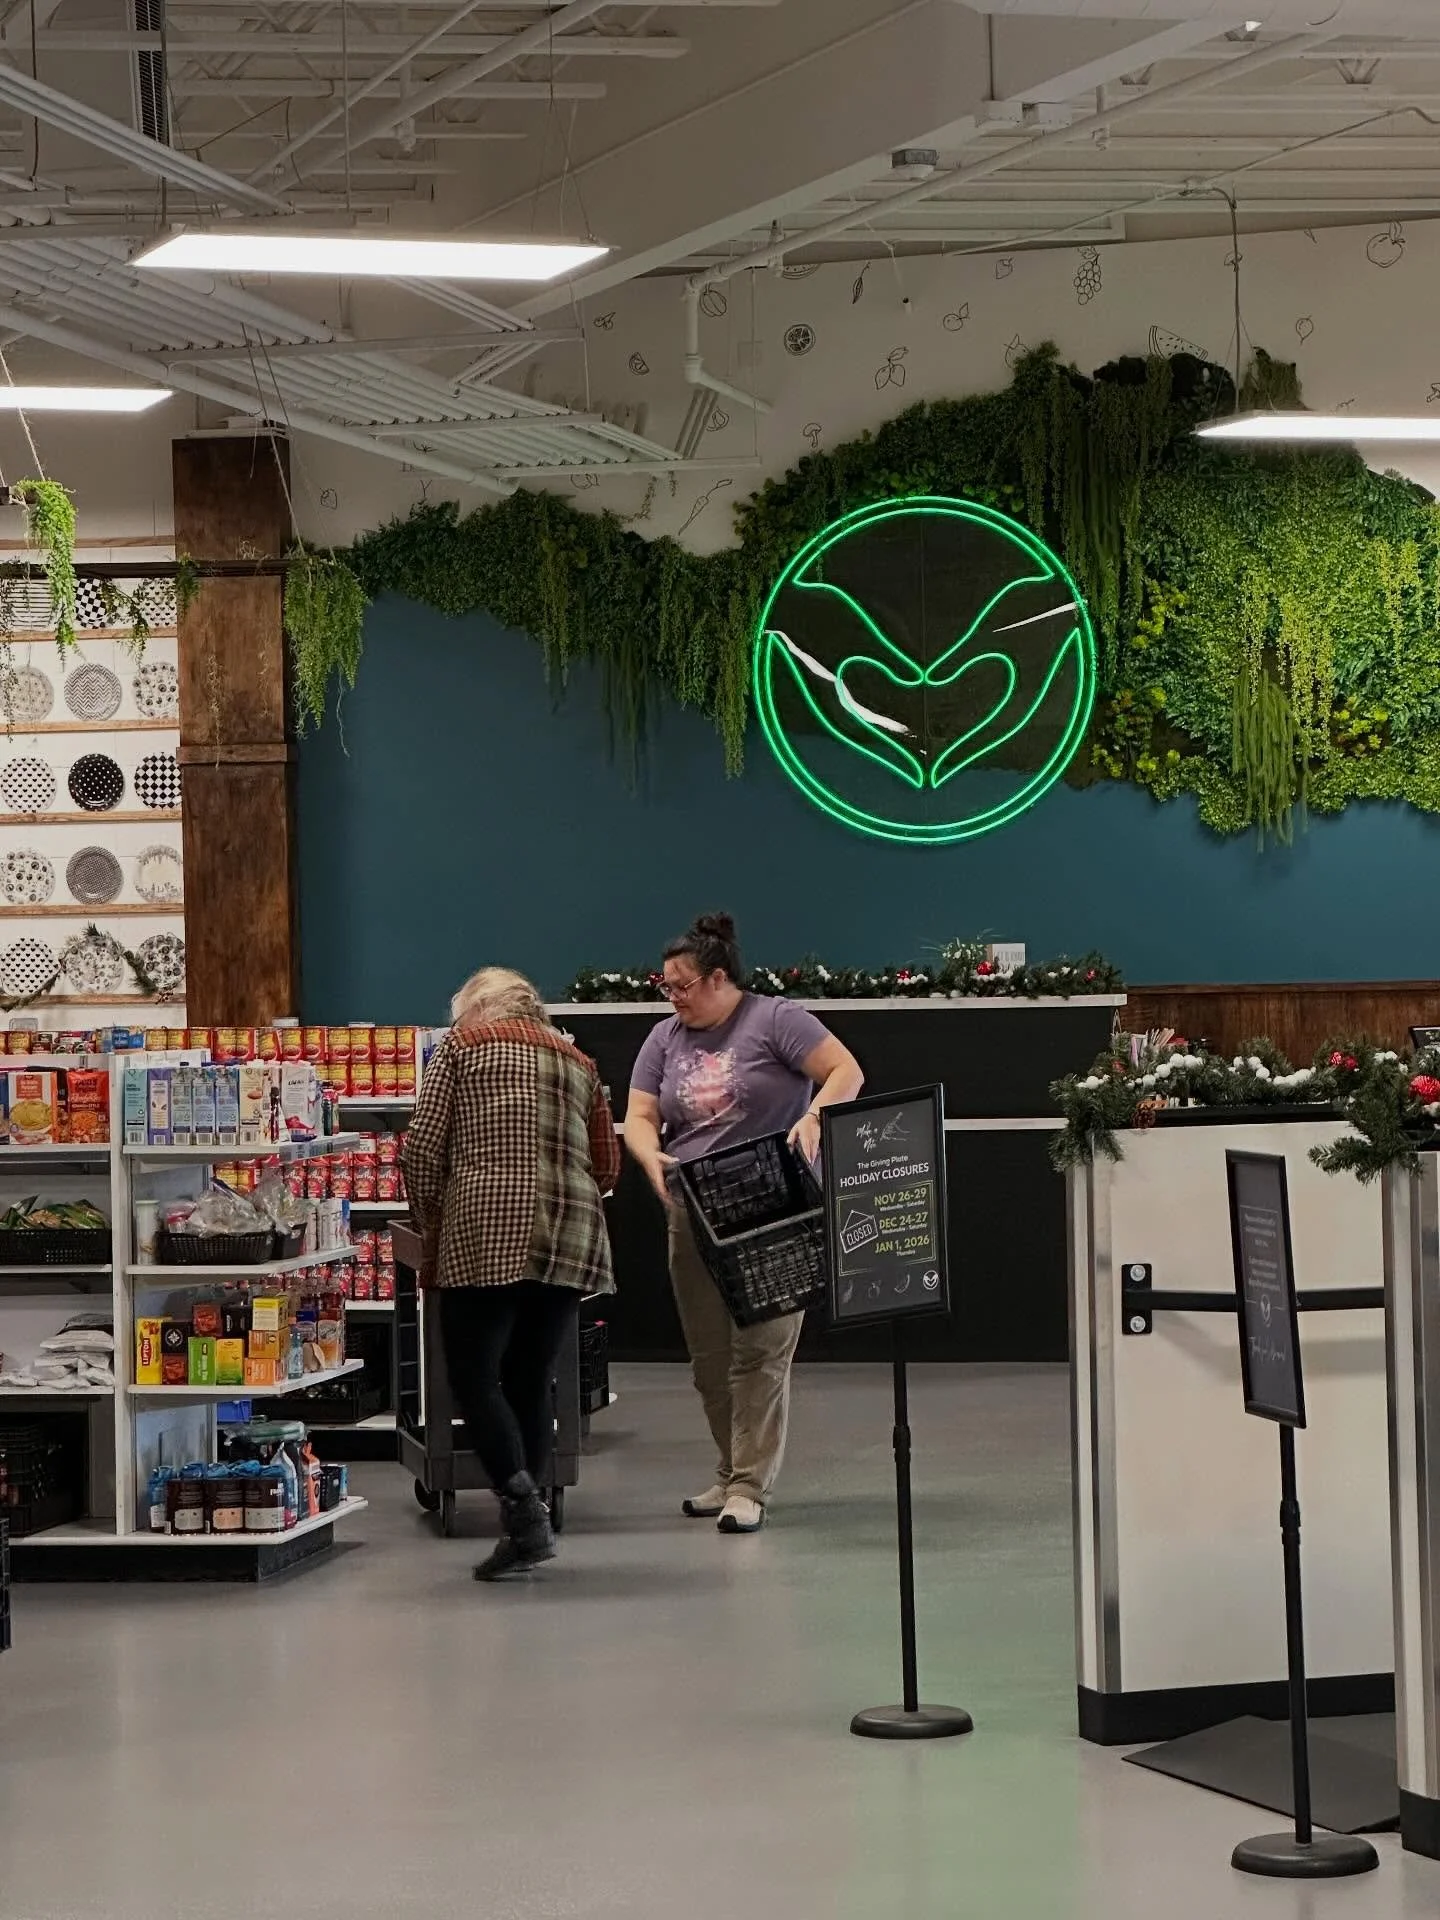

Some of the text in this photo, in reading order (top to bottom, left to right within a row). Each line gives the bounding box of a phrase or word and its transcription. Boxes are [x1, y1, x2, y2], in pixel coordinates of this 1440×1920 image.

[870, 1158, 890, 1167] Giving
[891, 1155, 908, 1163] Plate
[840, 1162, 929, 1187] HOLIDAY CLOSURES
[874, 1188, 927, 1206] NOV 26-29
[879, 1212, 928, 1229] DEC 24-27
[847, 1223, 873, 1245] CLOSED
[875, 1235, 930, 1253] JAN 1, 2026
